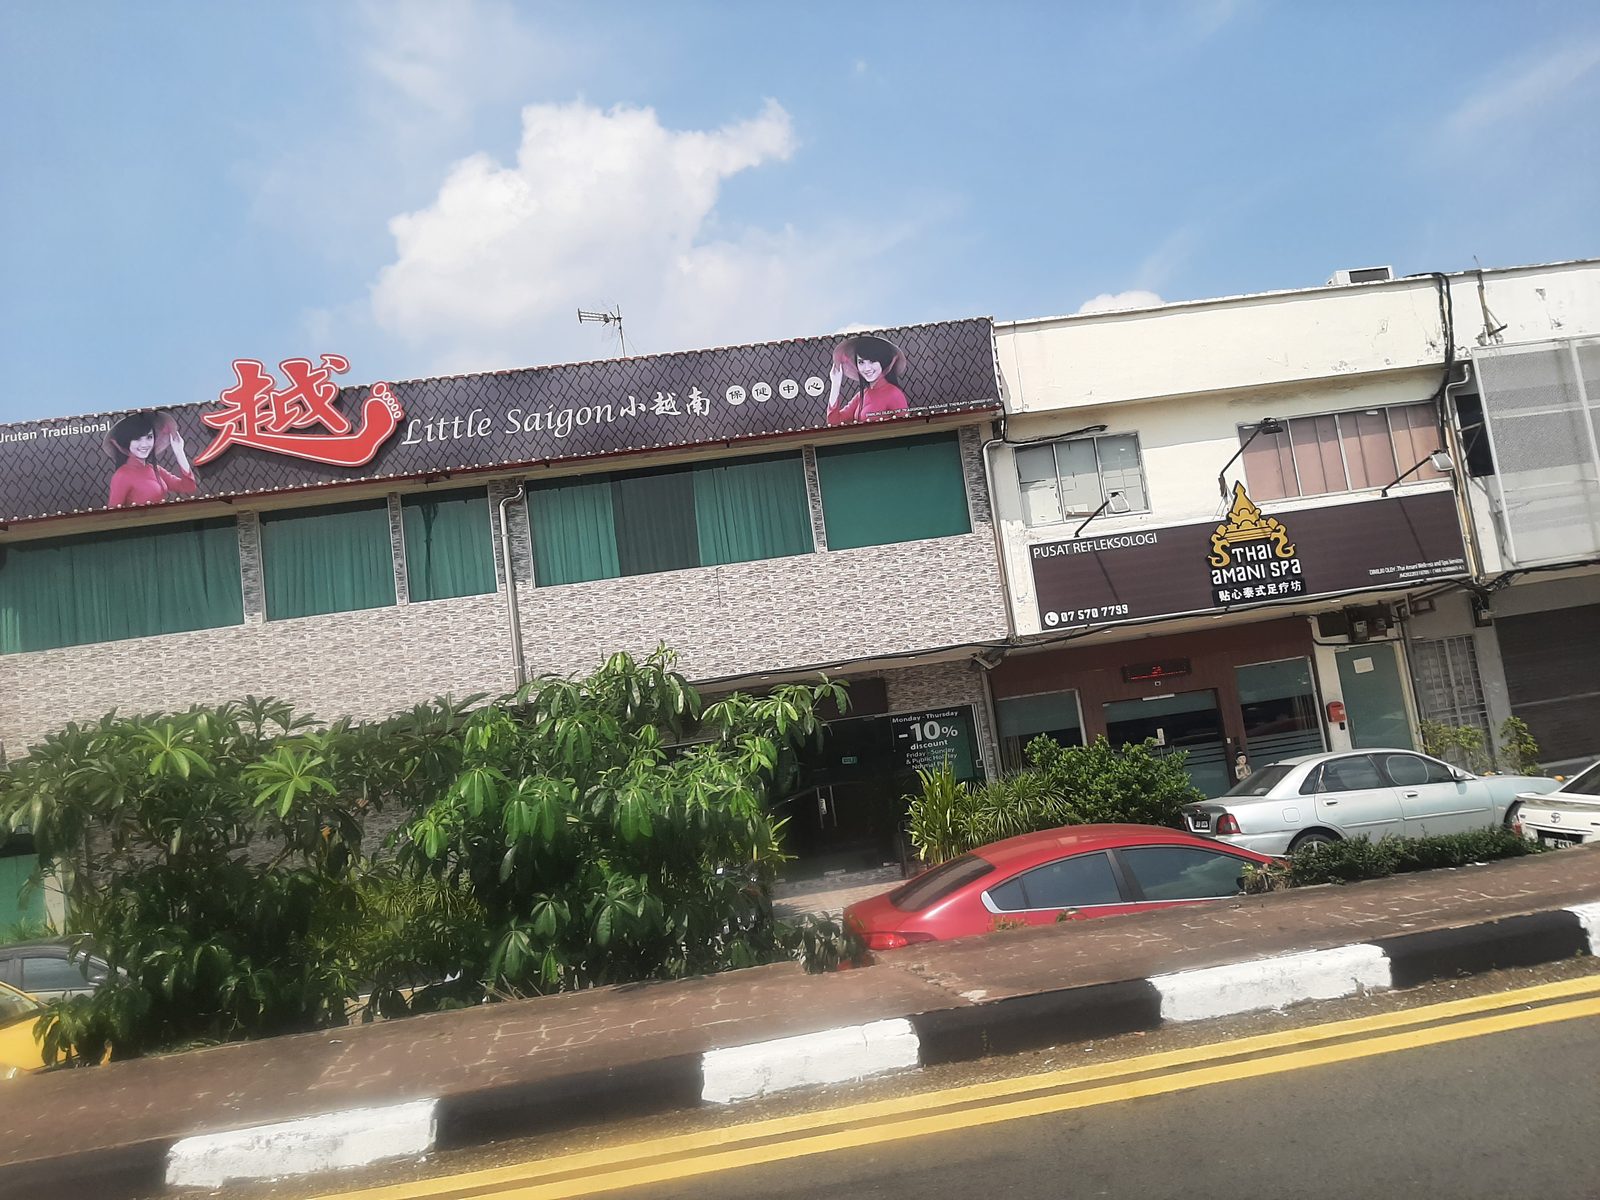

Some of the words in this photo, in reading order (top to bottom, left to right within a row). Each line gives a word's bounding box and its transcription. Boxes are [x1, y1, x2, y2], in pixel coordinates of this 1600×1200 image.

[620, 387, 711, 416] 小越南
[41, 421, 111, 438] Tradisional
[401, 408, 493, 445] Little
[505, 404, 616, 438] Saigon
[1033, 544, 1071, 558] PUSAT
[1073, 533, 1158, 553] REFLEKSOLOGI
[1218, 580, 1302, 602] 贴心泰式足疗坊
[1060, 611, 1075, 622] 07
[1078, 608, 1099, 620] 570
[1101, 604, 1129, 616] 7799
[926, 711, 959, 719] Thursday
[910, 740, 948, 750] discount
[906, 751, 926, 759] Friday
